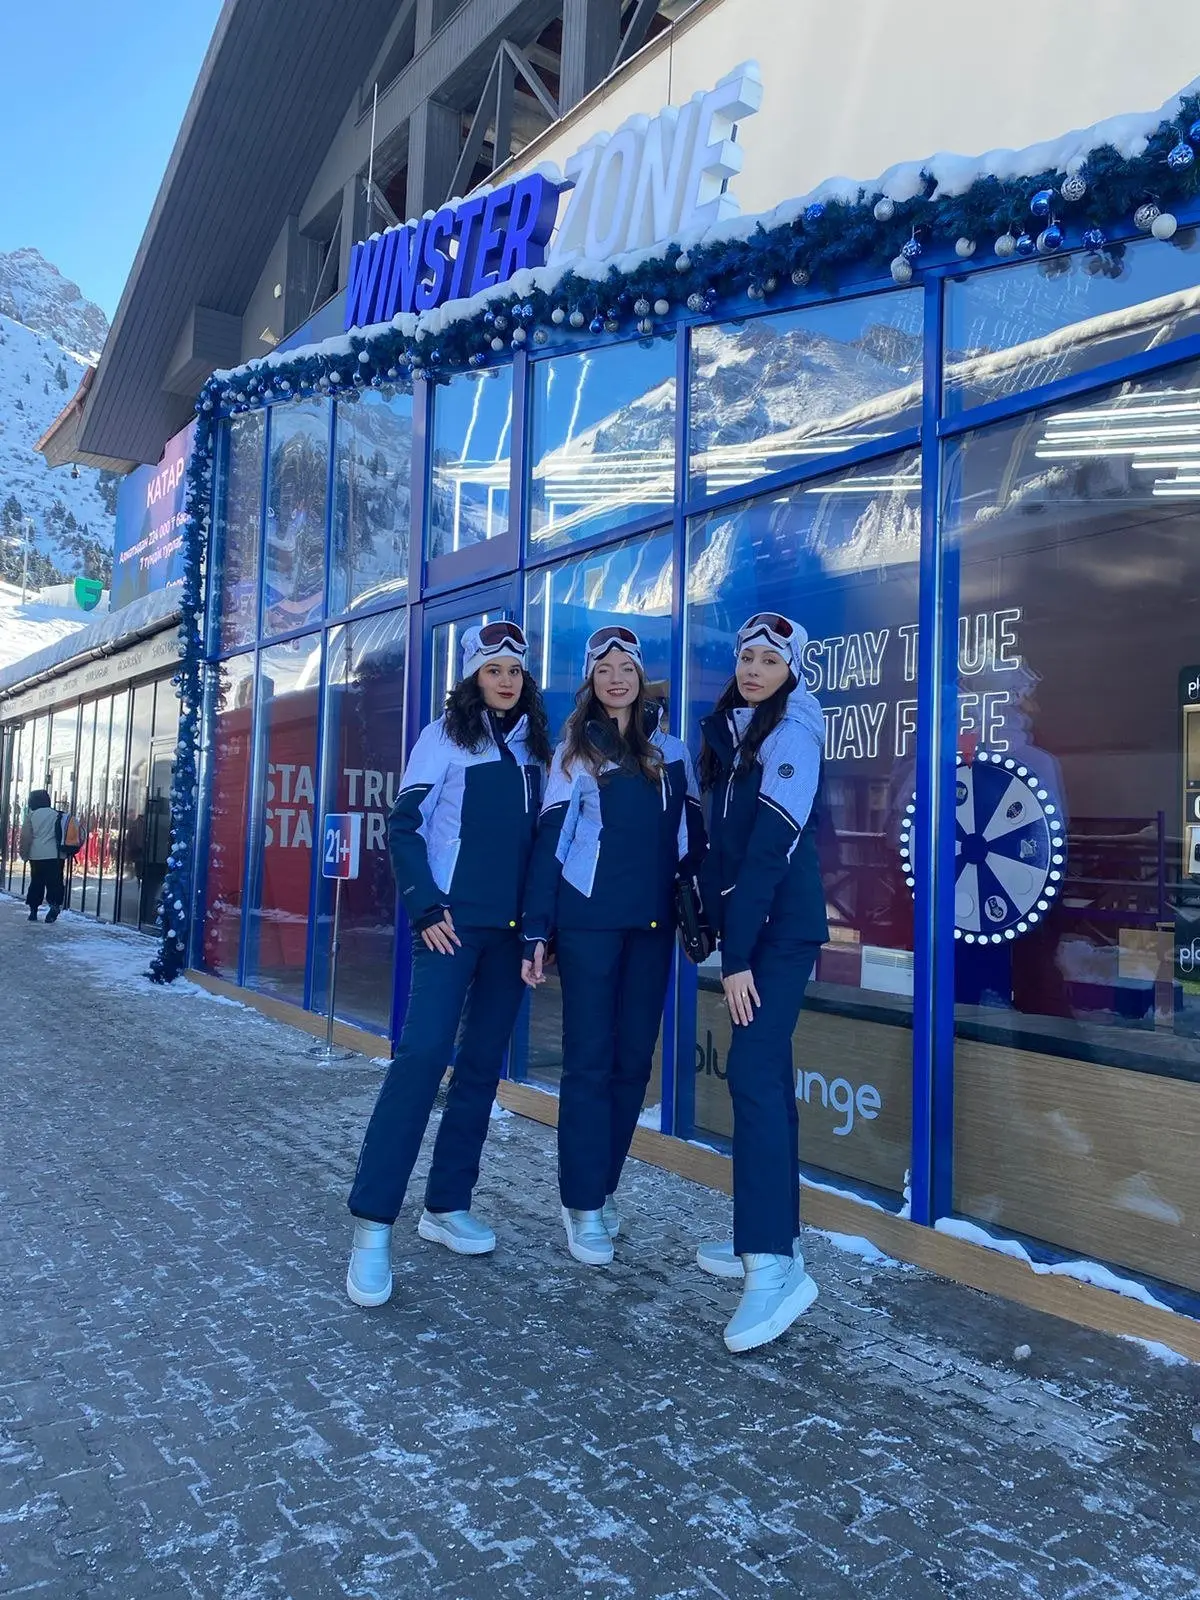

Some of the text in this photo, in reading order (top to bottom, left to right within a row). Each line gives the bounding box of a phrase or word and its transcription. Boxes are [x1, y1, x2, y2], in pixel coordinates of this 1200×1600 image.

[344, 76, 763, 331] WINSTER ZONE
[146, 457, 184, 508] КАТАР
[801, 608, 1021, 693] STAY TUE
[1188, 676, 1200, 698] pl
[821, 691, 1010, 760] TAY FEE
[267, 763, 396, 809] STA TRU
[264, 808, 313, 848] STA
[325, 828, 350, 863] 21+
[795, 1068, 882, 1136] nge
